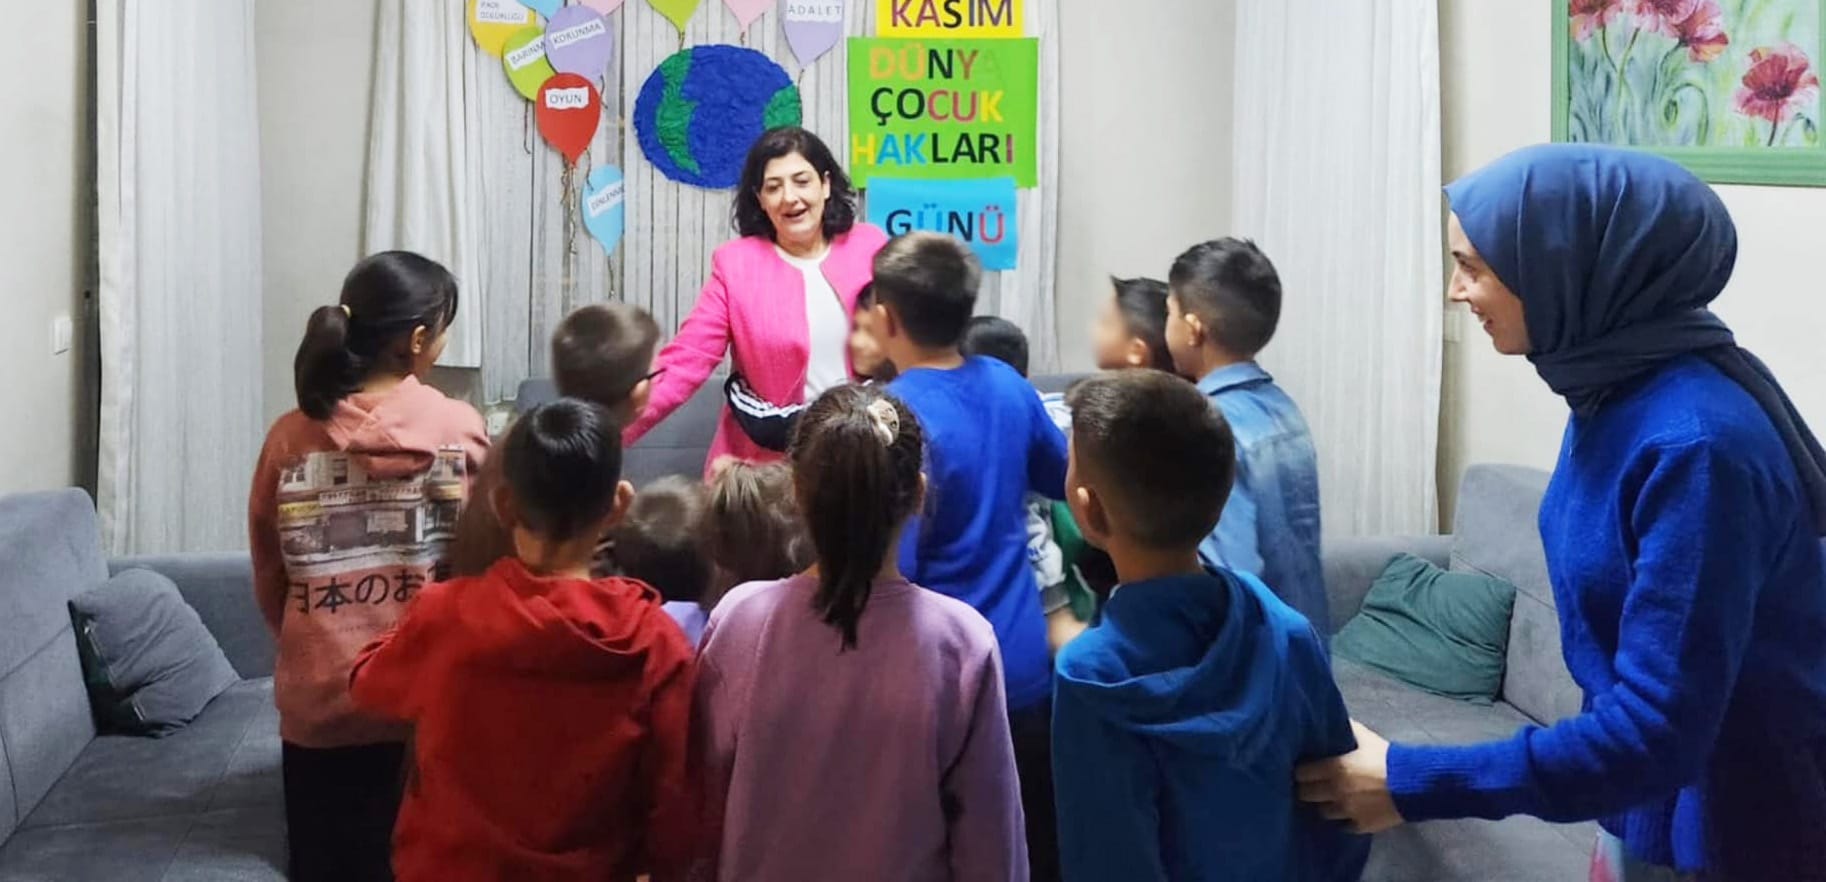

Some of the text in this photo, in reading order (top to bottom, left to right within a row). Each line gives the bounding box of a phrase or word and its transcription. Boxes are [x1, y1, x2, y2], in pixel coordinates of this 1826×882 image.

[787, 4, 842, 16] ADALET
[891, 0, 1013, 29] KASIM
[553, 22, 602, 44] KORUNMA
[549, 93, 583, 105] OYUN
[870, 87, 1005, 126] ÇOCUK
[852, 132, 1014, 166] HAKLARI
[886, 203, 1005, 244] GÜNÜ
